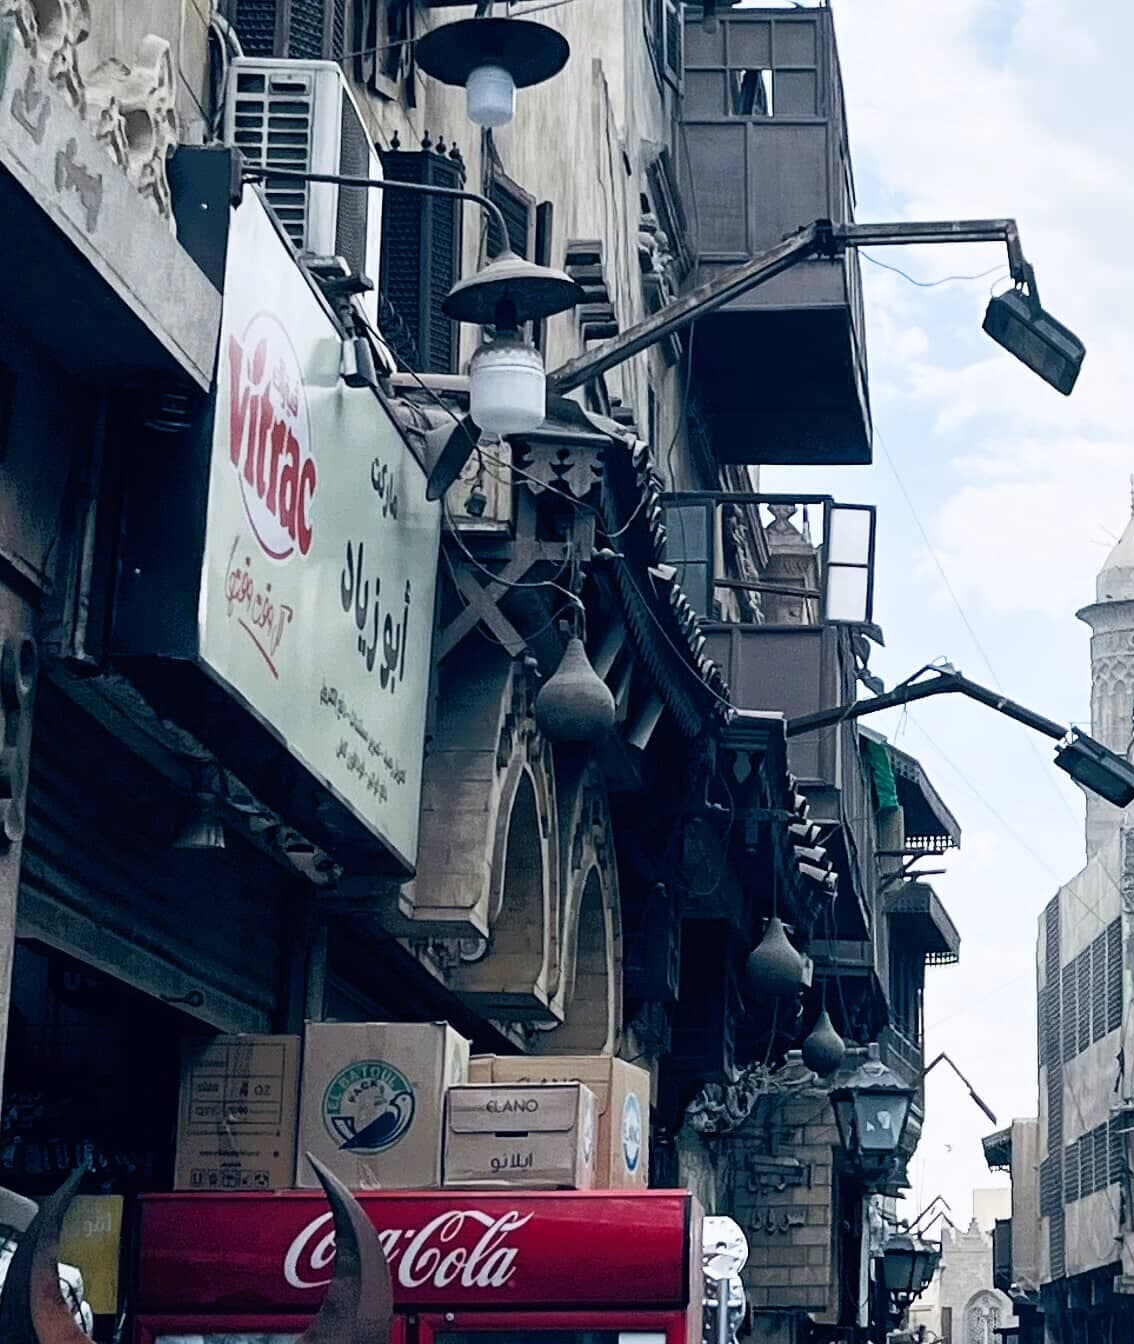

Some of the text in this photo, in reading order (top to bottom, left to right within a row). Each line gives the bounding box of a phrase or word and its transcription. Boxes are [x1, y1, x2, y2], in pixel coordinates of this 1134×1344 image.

[229, 334, 316, 556] Vitrac
[371, 457, 398, 520] ماركت
[486, 1099, 539, 1113] ELANO
